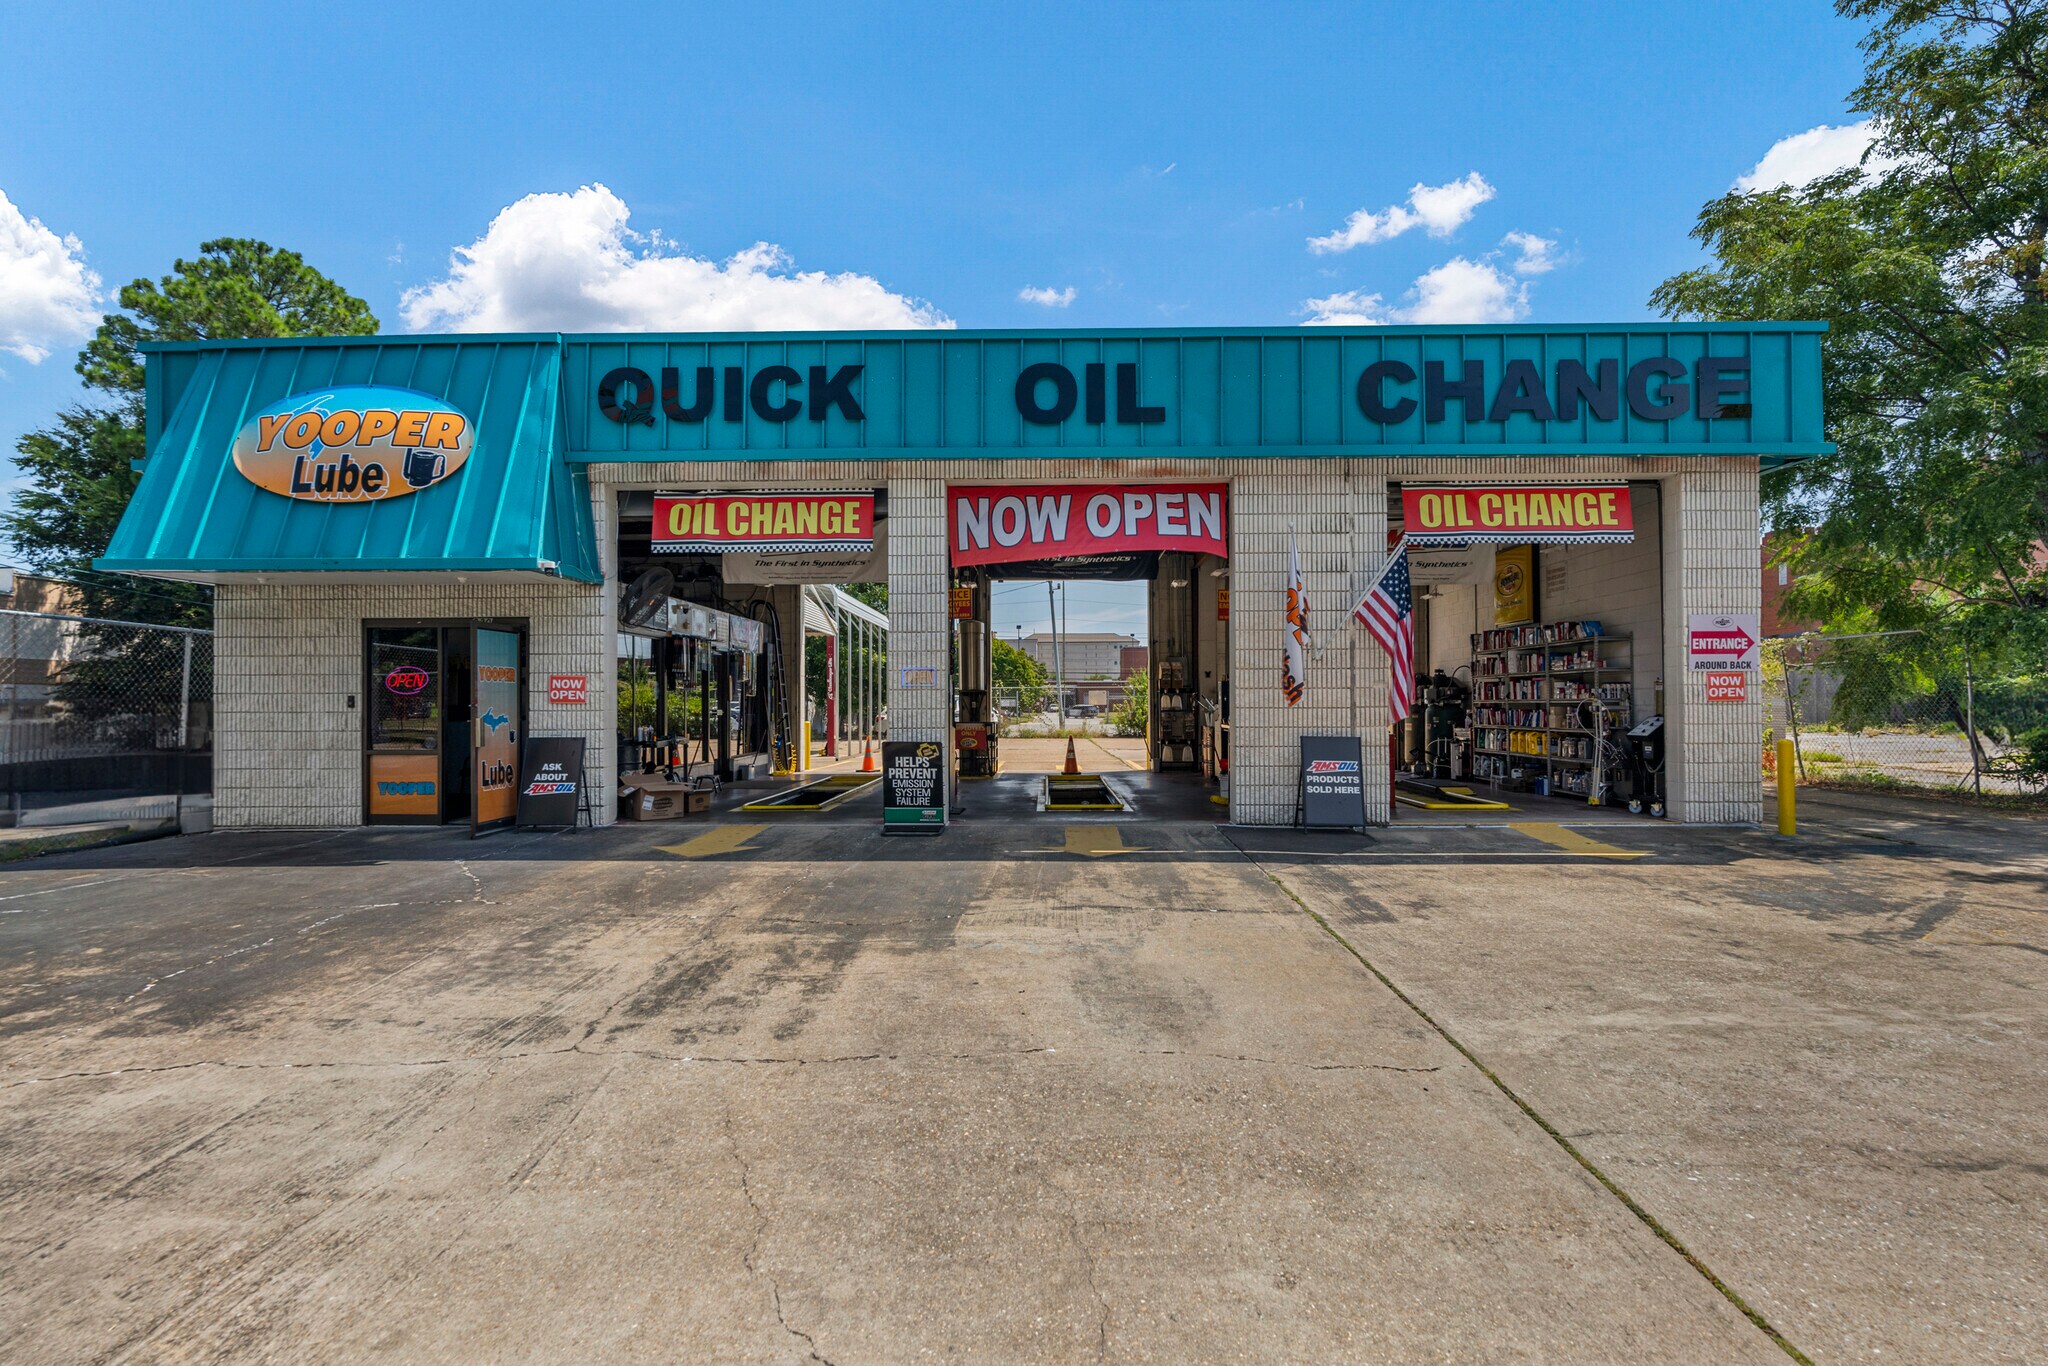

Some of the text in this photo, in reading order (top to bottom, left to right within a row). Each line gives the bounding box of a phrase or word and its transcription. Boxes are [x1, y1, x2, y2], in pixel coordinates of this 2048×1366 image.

[598, 356, 1752, 427] QUICK OIL CHANGE
[256, 410, 466, 453] YOOPER
[290, 453, 387, 497] Lube
[1419, 492, 1619, 528] OIL CHANGE
[668, 501, 861, 536] OIL CHANGE
[956, 492, 1222, 552] NOW OPEN
[812, 559, 866, 568] Synthetics
[1076, 556, 1132, 565] Synthetics
[1415, 561, 1468, 569] Synthetics
[1692, 638, 1749, 650] ENTRANCE
[1694, 661, 1752, 670] AROUND BACK
[478, 665, 516, 684] YOOPER
[387, 673, 425, 688] OPEN
[552, 679, 583, 689] NOW
[1710, 676, 1742, 686] NOW
[550, 690, 585, 700] OPEN
[1709, 687, 1745, 697] OPEN
[542, 763, 563, 771] ASK
[895, 756, 930, 768] HELPS
[1306, 760, 1360, 774] AMSOIL
[481, 759, 514, 792] Lube
[533, 773, 569, 781] ABOUT
[888, 768, 938, 779] PREVENT
[892, 779, 934, 788] EMISSION
[1306, 775, 1360, 784] PRODUCTS
[377, 781, 436, 796] YOOPER
[523, 782, 576, 796] AMSOIL
[895, 788, 931, 797] SYSTEM
[1306, 785, 1361, 794] SOLD HERE
[896, 797, 931, 806] FAILURE
